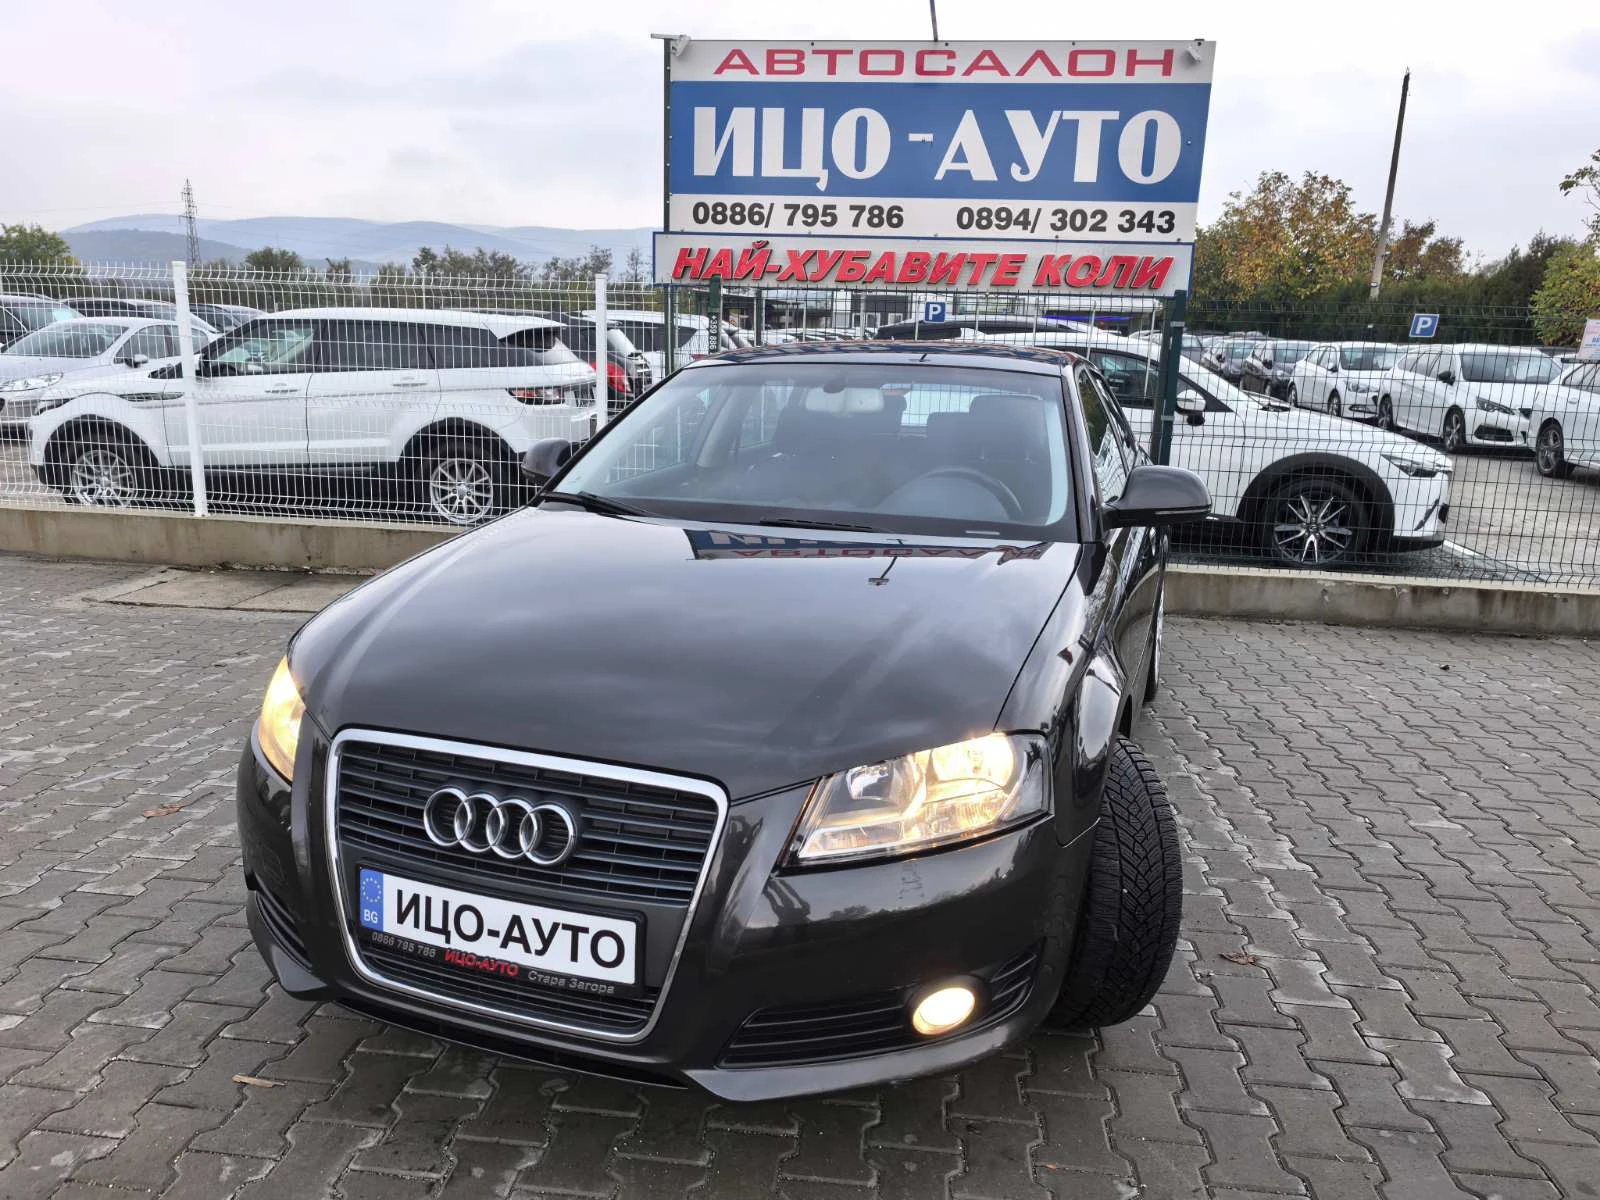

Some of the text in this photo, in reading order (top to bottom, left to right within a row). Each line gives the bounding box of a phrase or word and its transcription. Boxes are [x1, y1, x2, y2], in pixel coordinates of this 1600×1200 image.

[713, 48, 1174, 76] АВТОСАЛОН
[692, 202, 1175, 233] 0886/ 795 786 0894/ 302 343
[672, 240, 1174, 289] НАЙ-ХУБАВИТЕ КОЛИ
[929, 303, 941, 321] P
[1415, 317, 1433, 334] P
[364, 908, 378, 924] BG
[397, 889, 625, 968] ИЦО-АУТО
[444, 949, 519, 977] ИЦО-АУТО
[527, 970, 566, 988] Стара
[569, 977, 615, 994] Загора
